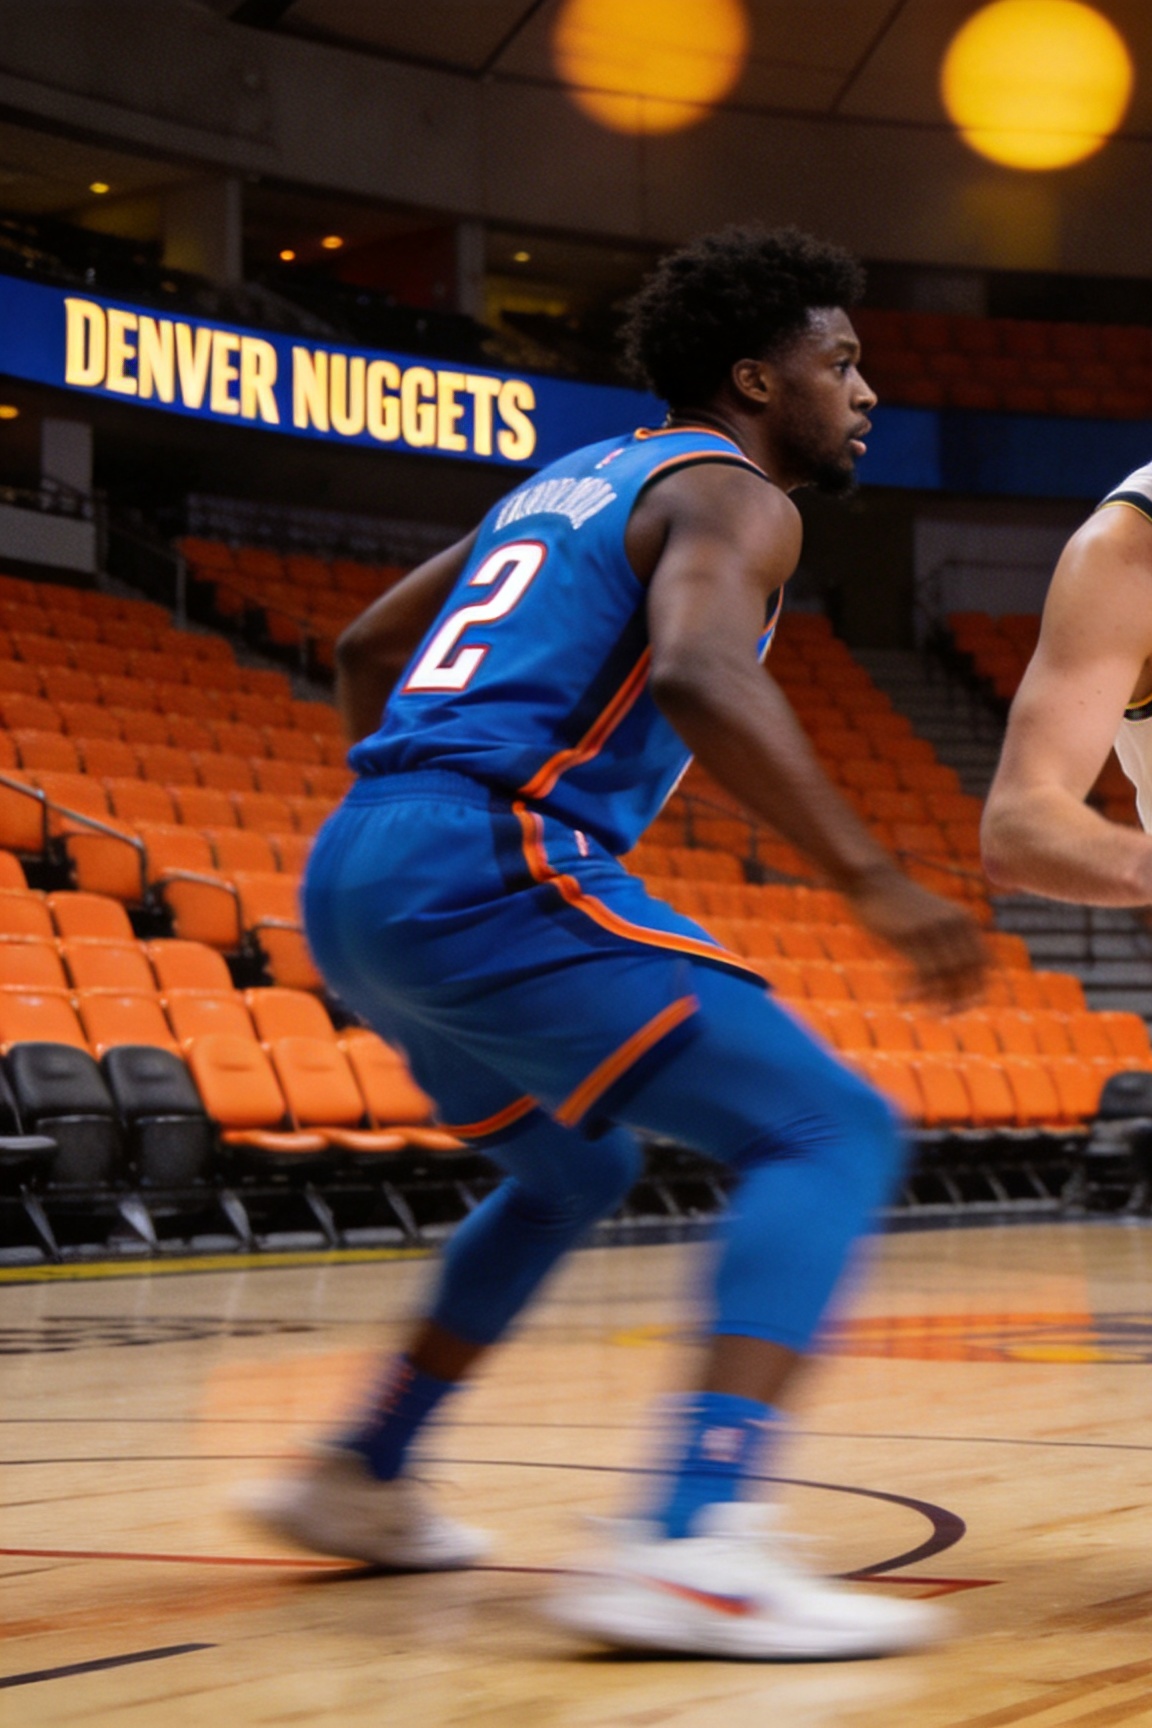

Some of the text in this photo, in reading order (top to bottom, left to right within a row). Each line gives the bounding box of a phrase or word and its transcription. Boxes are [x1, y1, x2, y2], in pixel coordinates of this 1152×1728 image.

[64, 296, 536, 461] DENVER NUGGETS
[399, 538, 548, 695] 2
